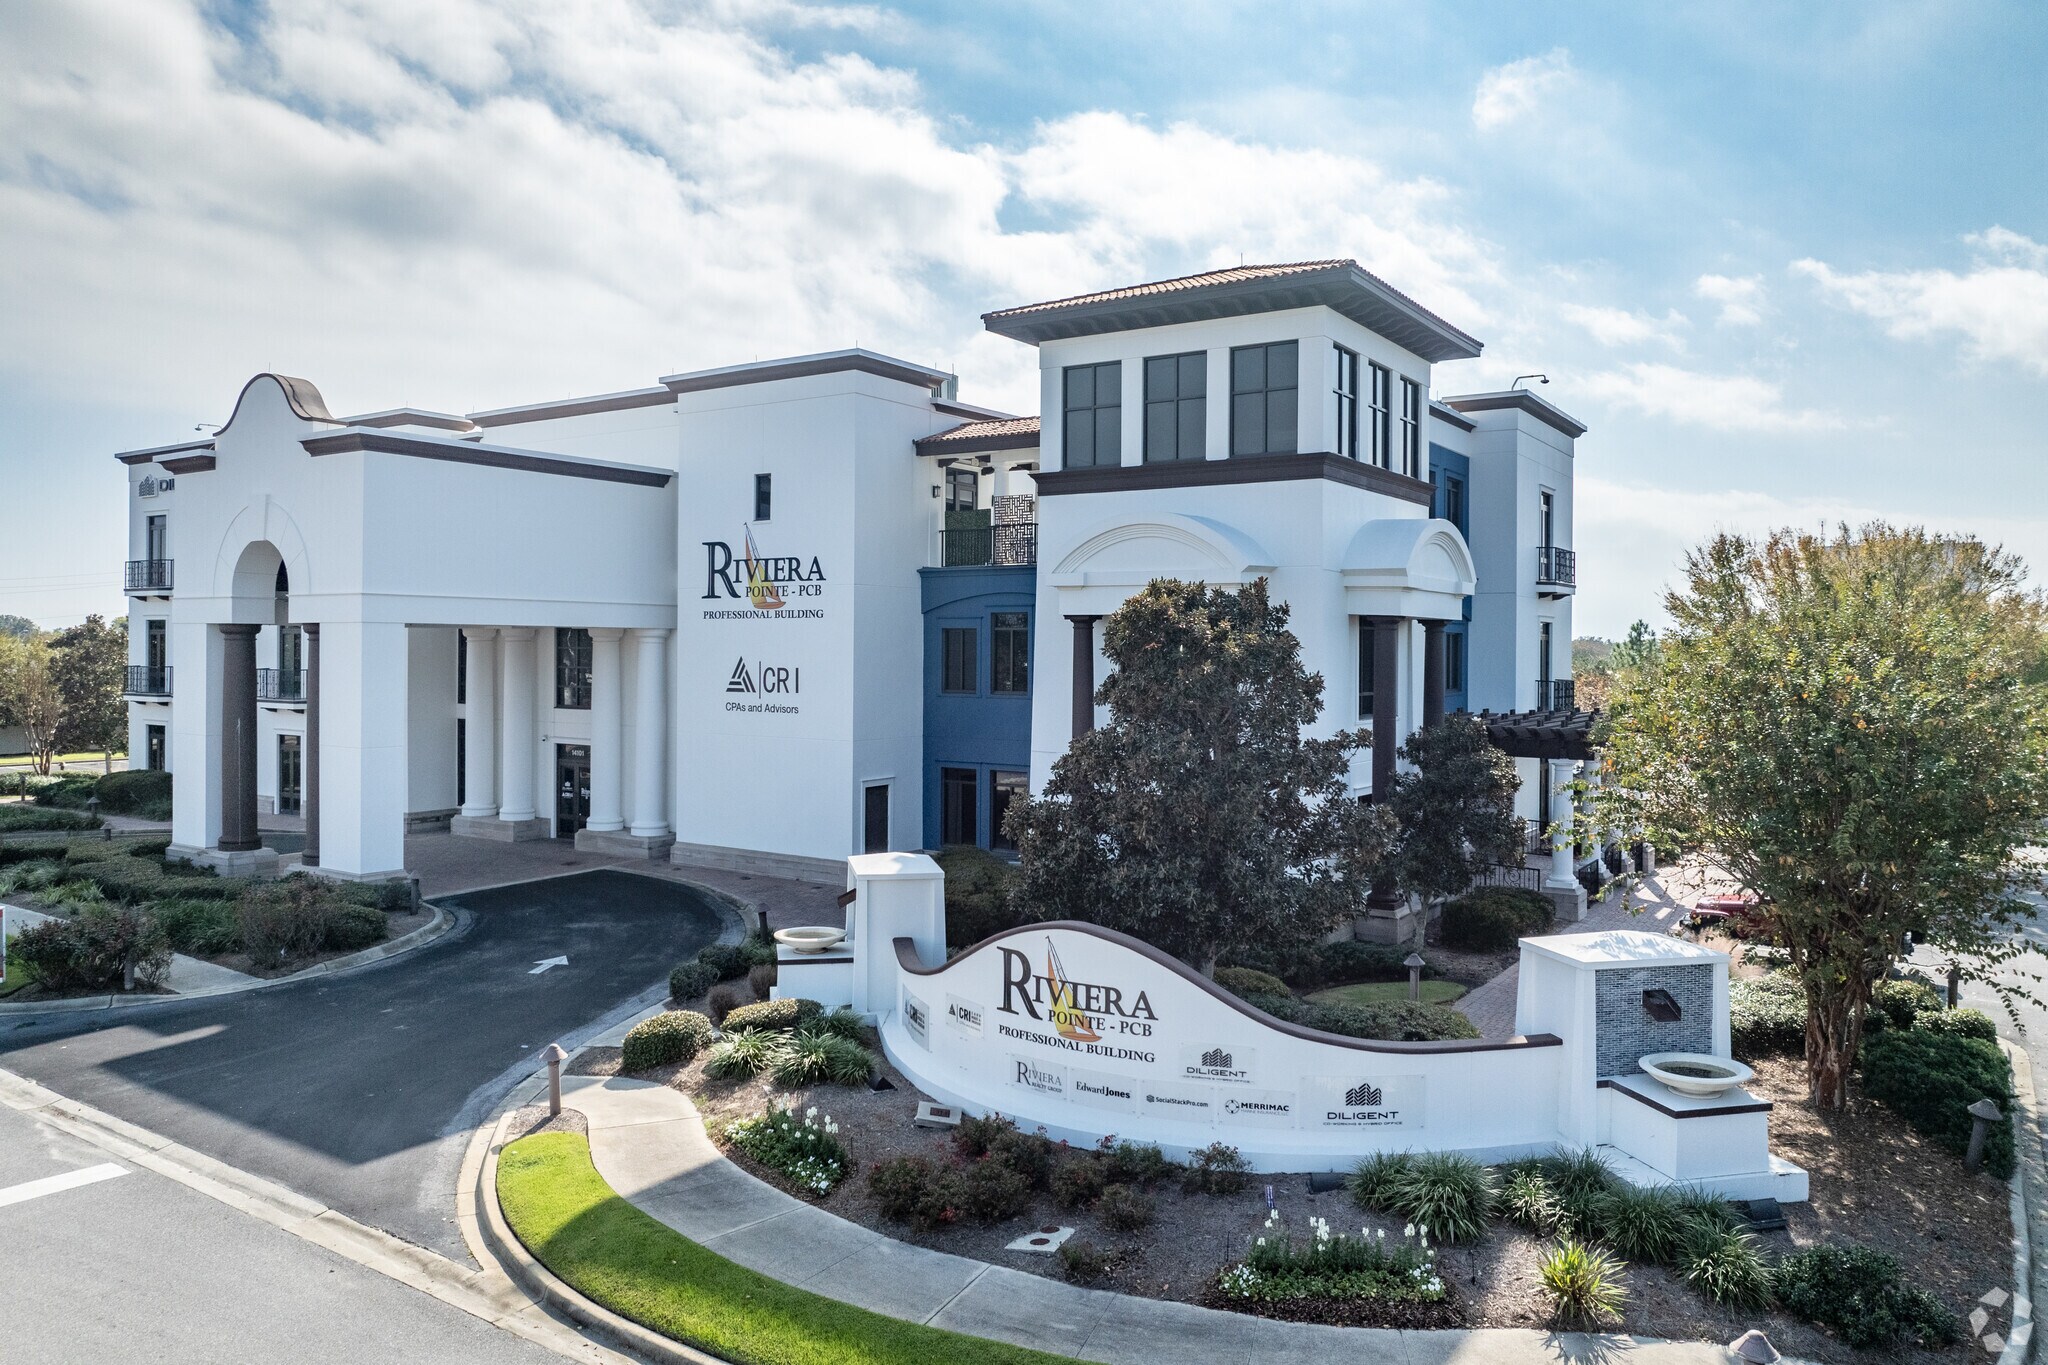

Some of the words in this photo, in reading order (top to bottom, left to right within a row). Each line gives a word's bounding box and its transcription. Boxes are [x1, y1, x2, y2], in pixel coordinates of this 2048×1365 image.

[701, 541, 827, 599] RIVIERA
[745, 585, 789, 598] POINTE
[798, 584, 822, 597] PCB
[703, 610, 772, 620] PROFESSIONAL
[774, 609, 824, 619] BUILDING
[763, 667, 799, 694] CRI
[725, 702, 746, 712] CPAs
[747, 704, 762, 713] and
[764, 703, 799, 714] Advisors
[997, 945, 1159, 1021] RIVIERA
[959, 1007, 971, 1022] CRI
[1047, 1008, 1106, 1031] POINTE
[1120, 1021, 1152, 1037] PCB
[998, 1024, 1083, 1052] PROFESSIONAL
[1086, 1043, 1155, 1063] BUILDING
[1016, 1061, 1062, 1086] RIVIERA
[1186, 1066, 1247, 1078] DILIGENT
[1156, 1096, 1209, 1107] SocialStackPro.com
[1241, 1102, 1289, 1112] MERRIMAC
[1327, 1111, 1399, 1120] DILIGENT
